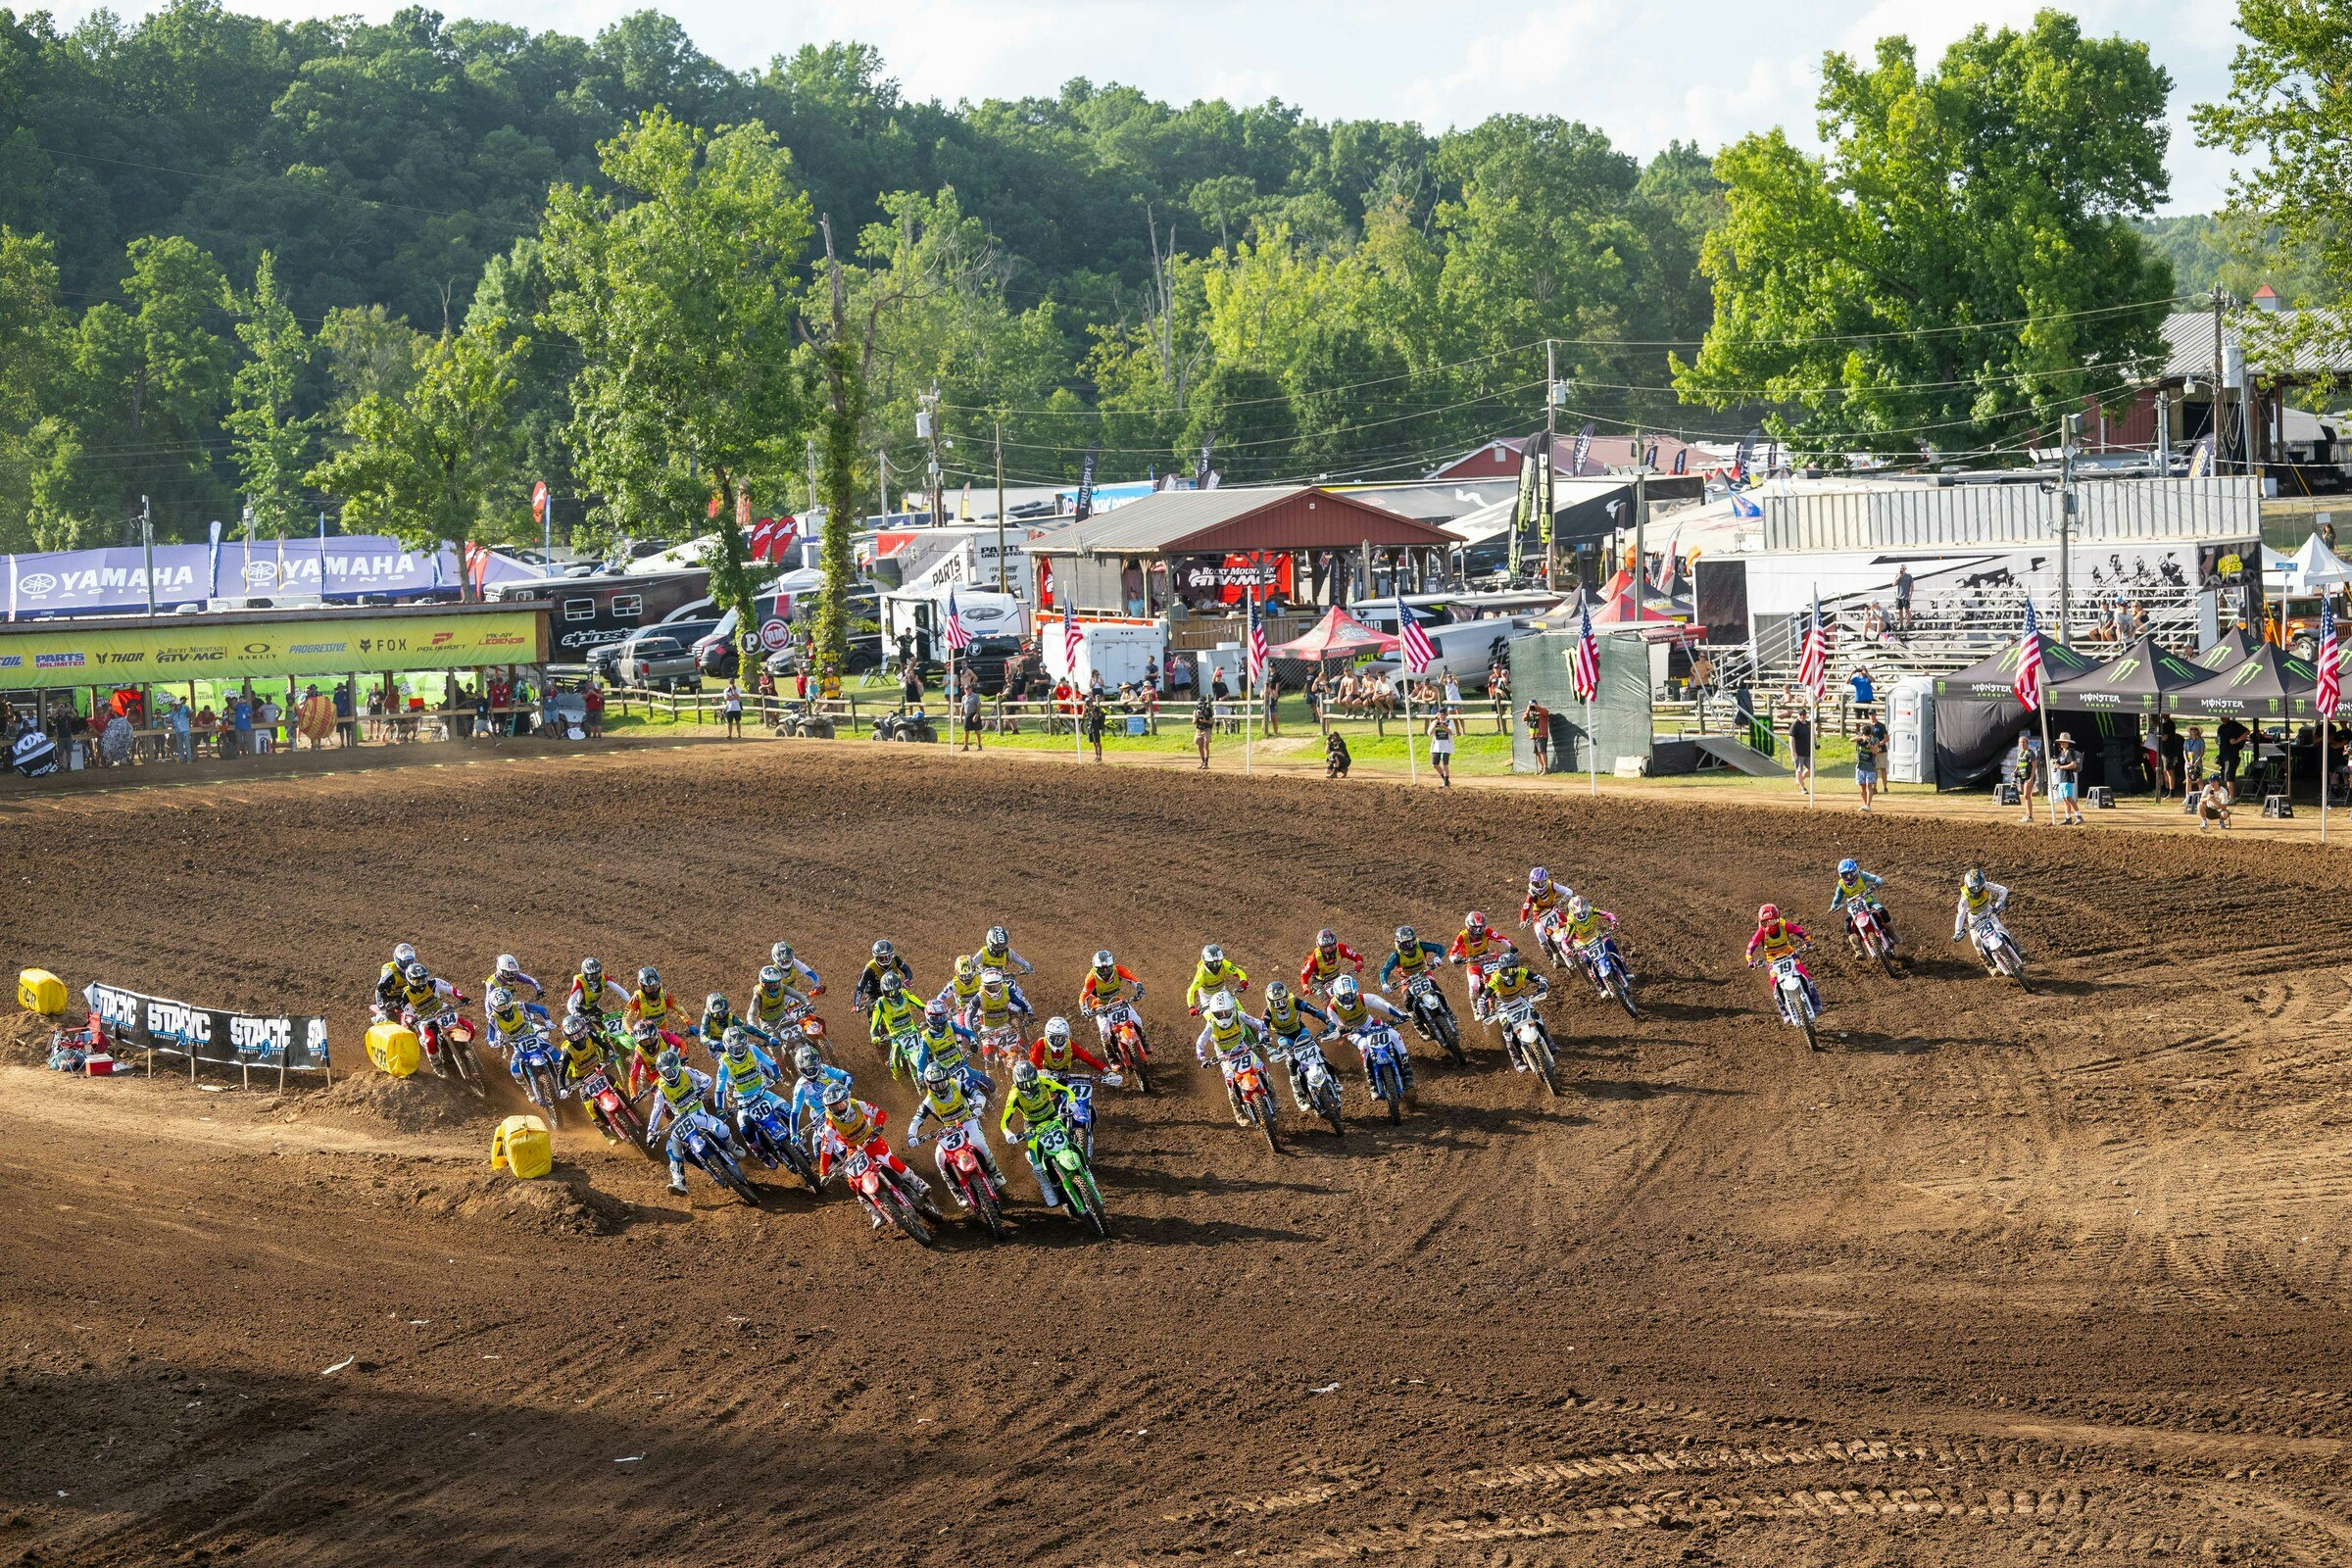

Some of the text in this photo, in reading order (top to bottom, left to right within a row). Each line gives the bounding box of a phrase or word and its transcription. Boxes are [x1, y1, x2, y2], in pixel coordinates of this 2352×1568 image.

[1079, 467, 1092, 509] TRIUMPH
[1539, 454, 1551, 543] PHOTOS
[283, 554, 415, 578] YAMAHA
[933, 554, 961, 587] PARTS
[2218, 555, 2240, 570] MOTO
[61, 565, 193, 591] YAMAHA
[2222, 563, 2243, 580] TEES
[1195, 575, 1232, 587] ATV
[377, 639, 407, 651] FOX
[562, 628, 637, 647] alpinesta
[745, 633, 758, 651] P
[289, 642, 347, 654] PROGRESSIVE
[0, 656, 23, 666] OIL
[35, 653, 84, 662] PARTS
[111, 652, 144, 662] THOR
[158, 654, 188, 663] ATV
[195, 652, 224, 661] MC
[1972, 683, 2012, 694] MONSTER
[2080, 693, 2121, 704] MONSTER
[2201, 698, 2244, 709] MONSTER
[1545, 913, 1559, 928] 41
[1978, 921, 1994, 939] 29
[1589, 943, 1604, 958] 51
[1484, 962, 1498, 974] 28
[1778, 960, 1791, 974] 19
[1412, 980, 1430, 997] 66
[148, 1003, 211, 1041] STACYC
[441, 1013, 457, 1026] 84
[1112, 1009, 1128, 1023] 99
[1512, 1007, 1529, 1024] 31
[608, 1019, 622, 1033] 27
[521, 1038, 538, 1054] 12
[903, 1034, 919, 1050] 21
[1370, 1032, 1389, 1049] 40
[1299, 1047, 1317, 1062] 44
[1232, 1055, 1250, 1072] 79
[588, 1075, 608, 1097] 48
[1072, 1085, 1091, 1098] 47
[752, 1102, 771, 1122] 36
[675, 1117, 696, 1140] 88
[946, 1132, 961, 1150] 3
[1044, 1130, 1065, 1151] 33
[850, 1154, 868, 1176] 73
